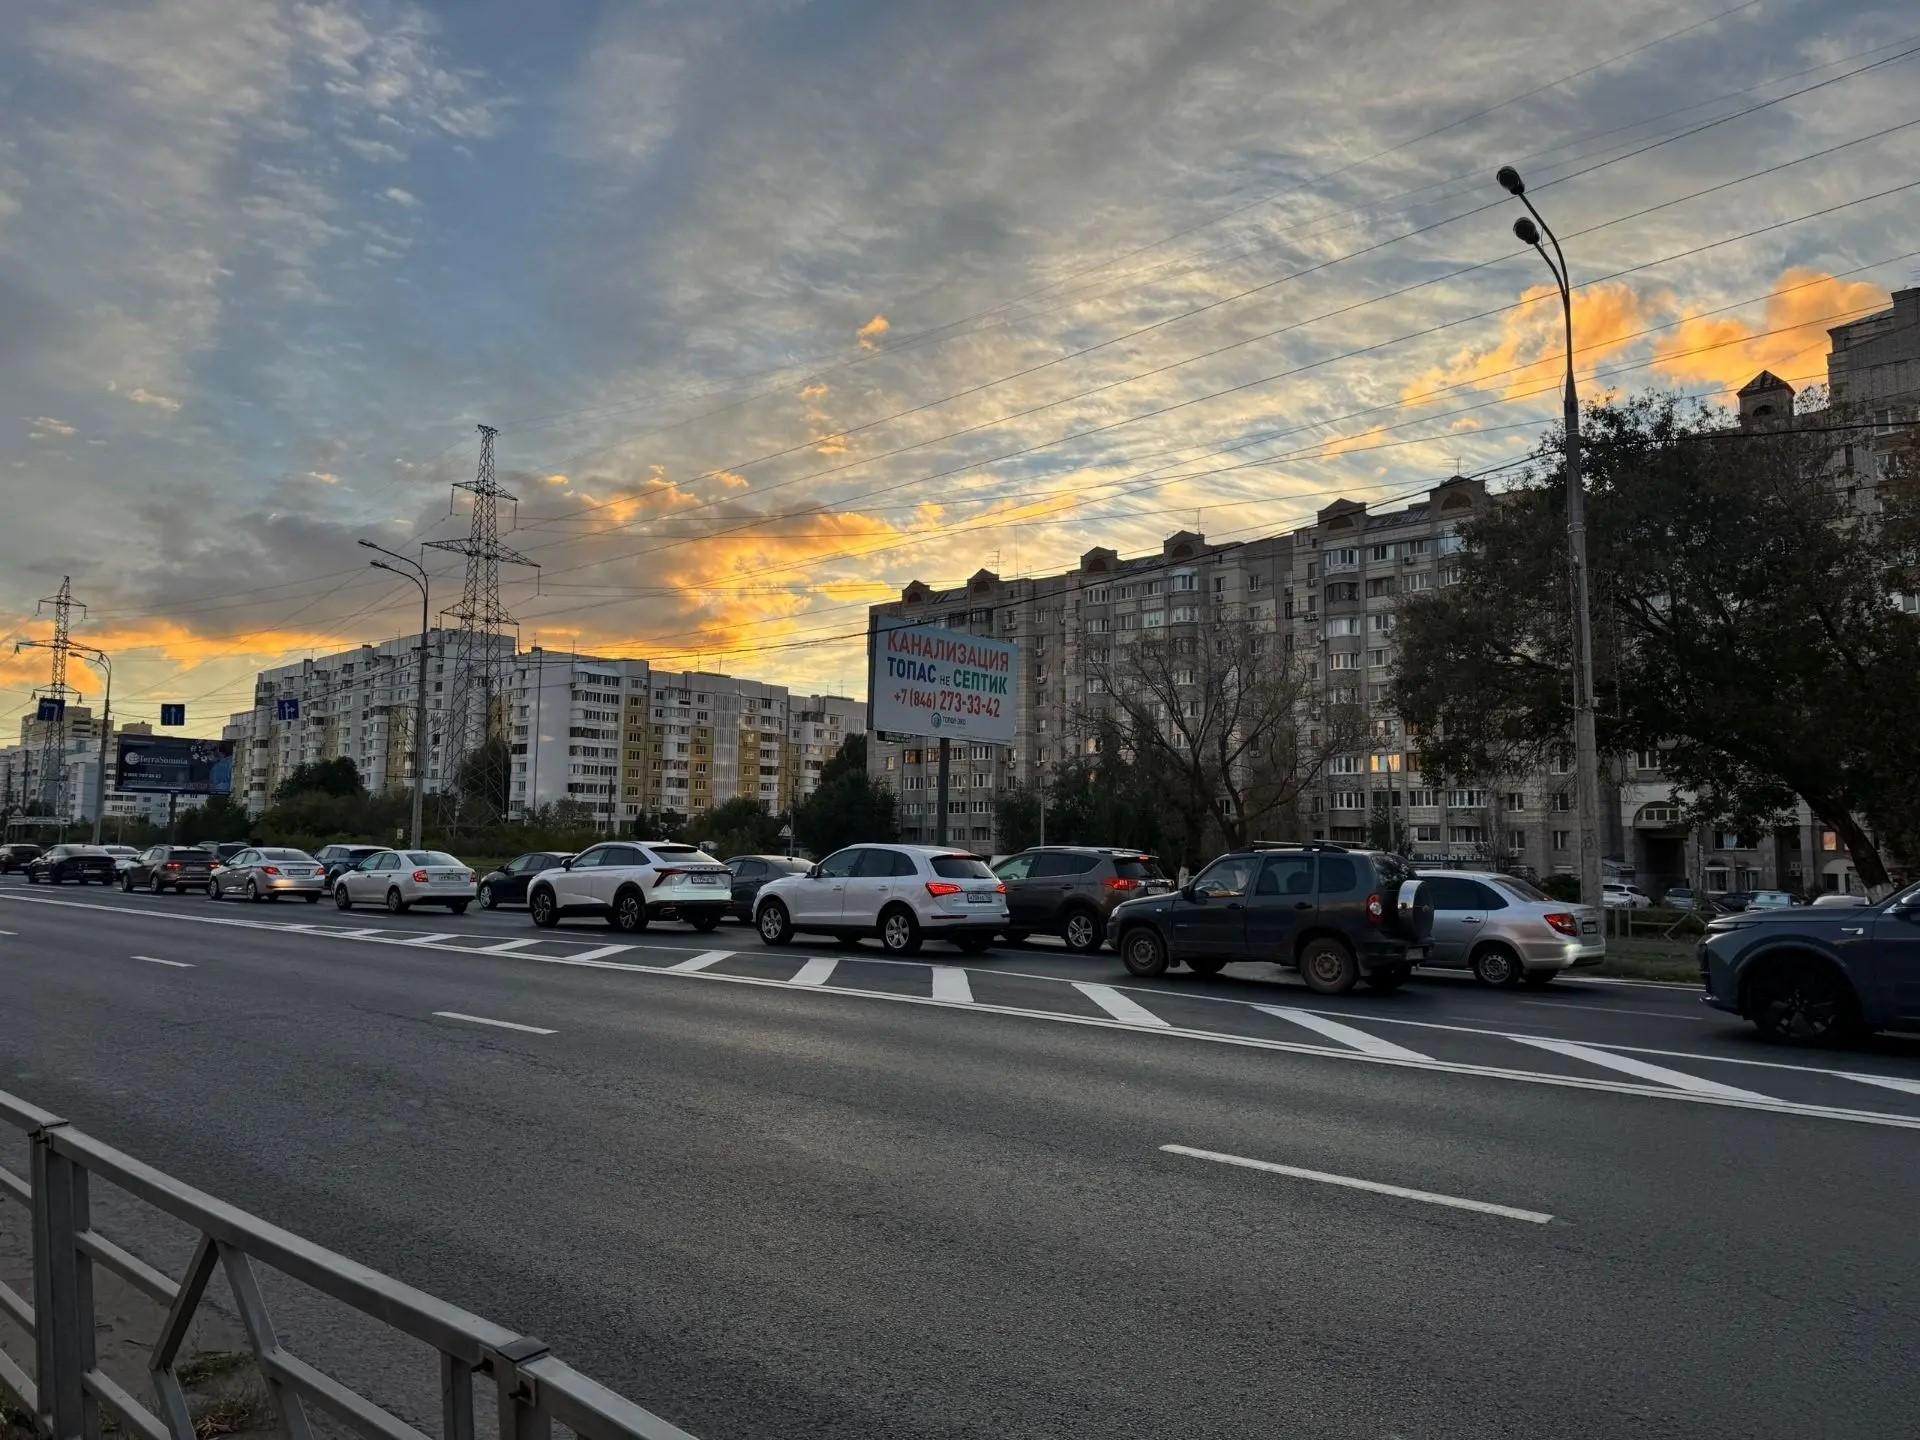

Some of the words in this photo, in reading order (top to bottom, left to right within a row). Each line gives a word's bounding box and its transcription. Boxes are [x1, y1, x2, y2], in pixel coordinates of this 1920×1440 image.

[887, 630, 1009, 672] КАНАЛИЗАЦИЯ
[887, 656, 937, 684] ТОПАС
[939, 675, 950, 687] НЕ
[953, 669, 1008, 695] СЕПТИК
[894, 688, 907, 705] +7
[909, 688, 937, 710] (846)
[939, 690, 1000, 718] 273-33-42
